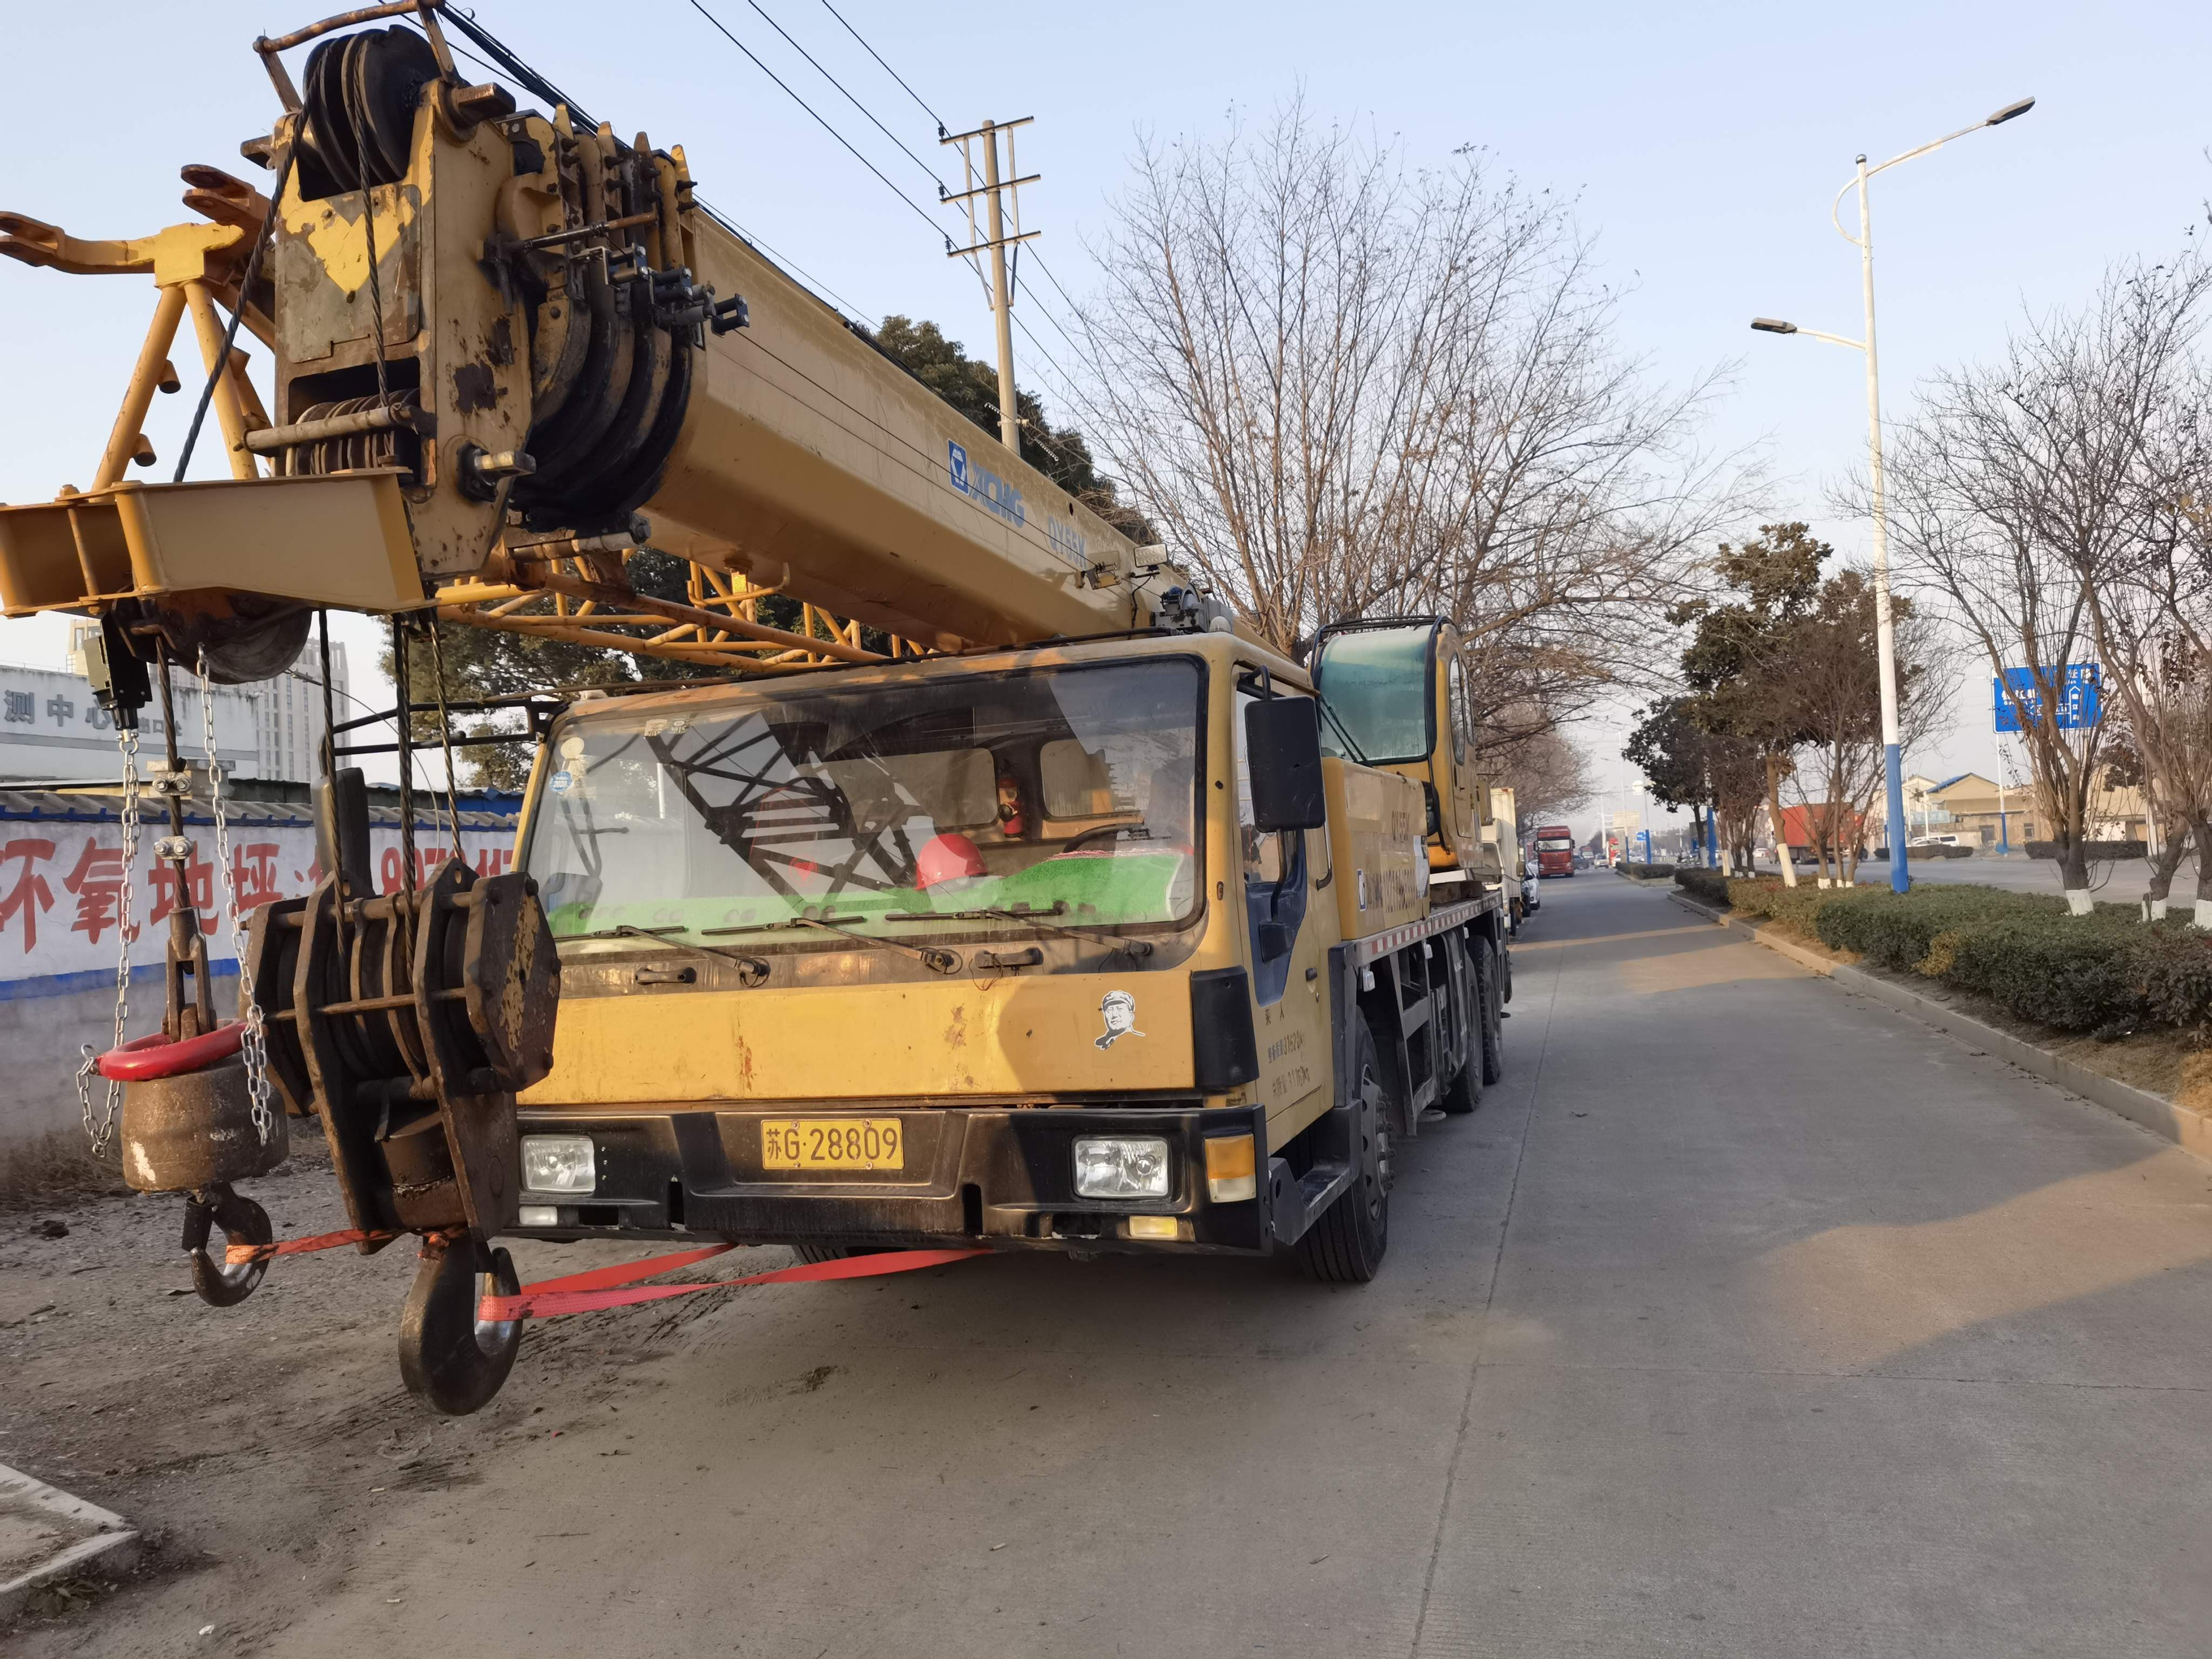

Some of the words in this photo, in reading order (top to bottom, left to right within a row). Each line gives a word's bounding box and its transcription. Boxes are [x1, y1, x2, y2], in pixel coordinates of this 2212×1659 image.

[969, 461, 1024, 528] XCMG
[4, 690, 111, 730] 测中心
[0, 837, 329, 954] 环氧地坪
